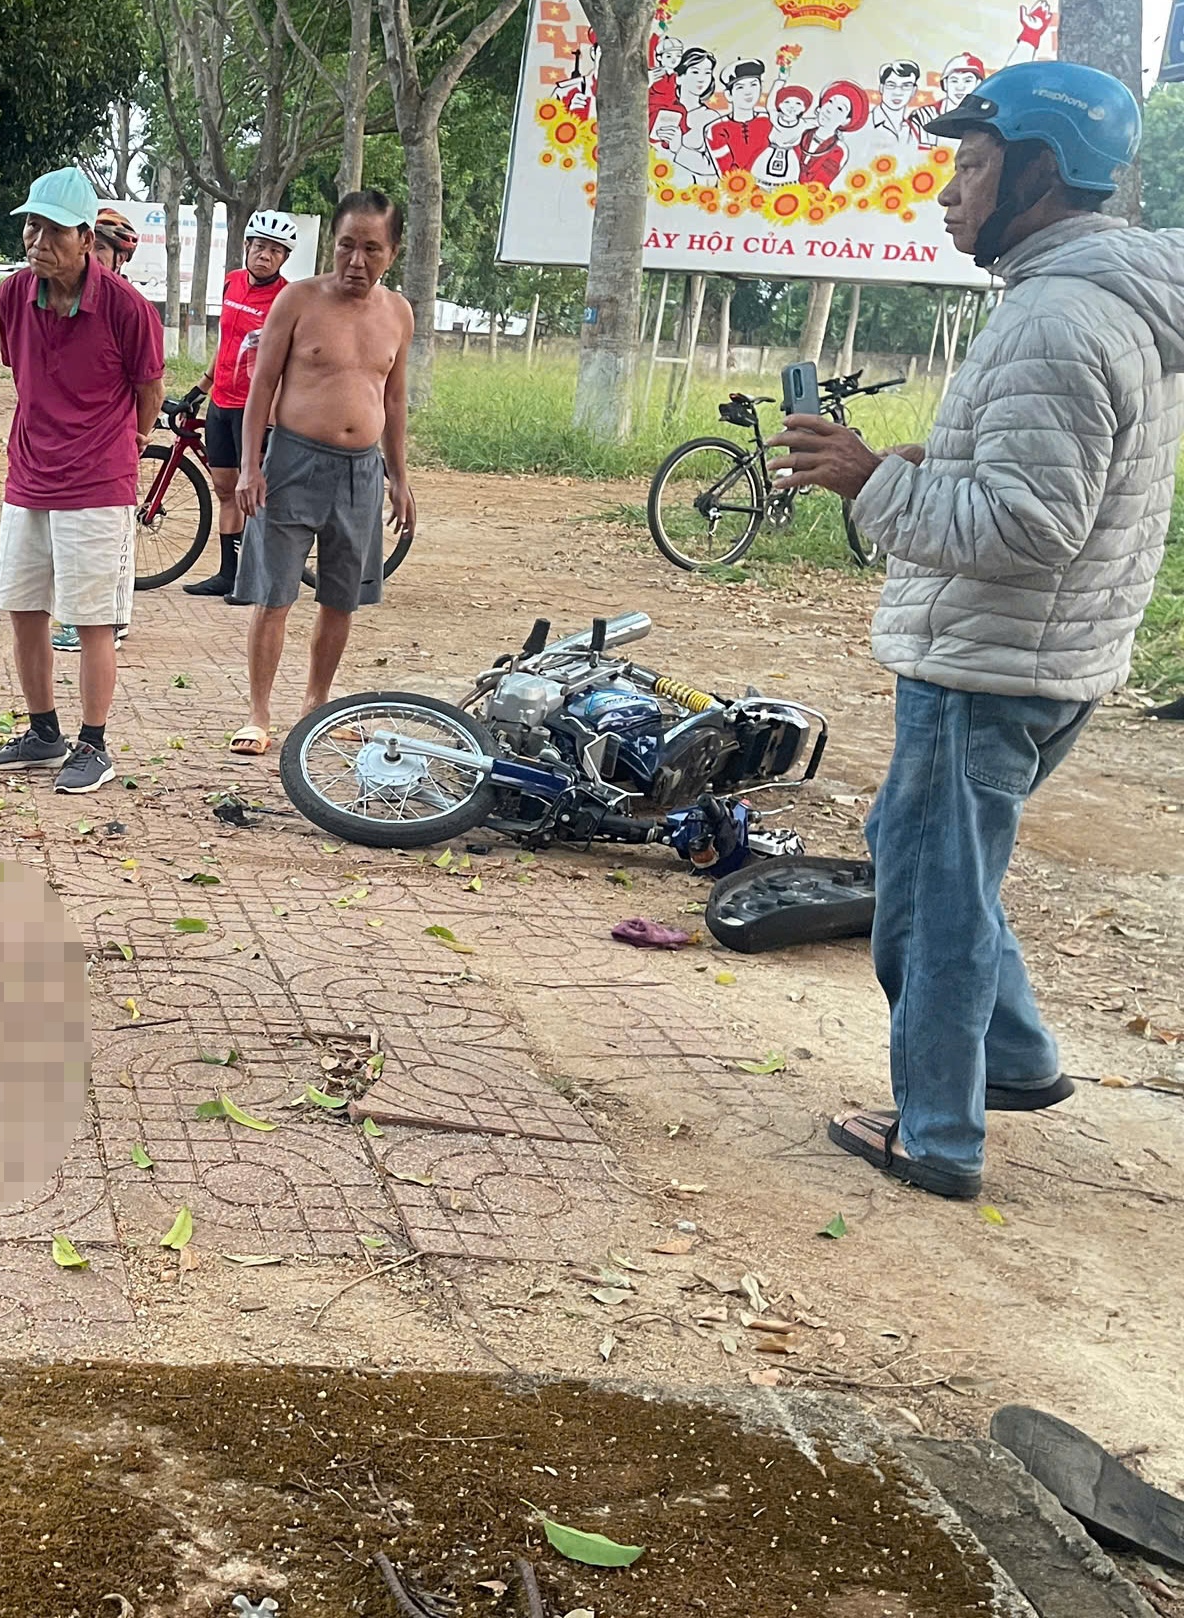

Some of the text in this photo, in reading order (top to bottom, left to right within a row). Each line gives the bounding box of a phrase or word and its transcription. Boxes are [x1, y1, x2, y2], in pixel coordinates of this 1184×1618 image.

[642, 227, 940, 263] ÀY HỘI CỦA TOÀN DÂN
